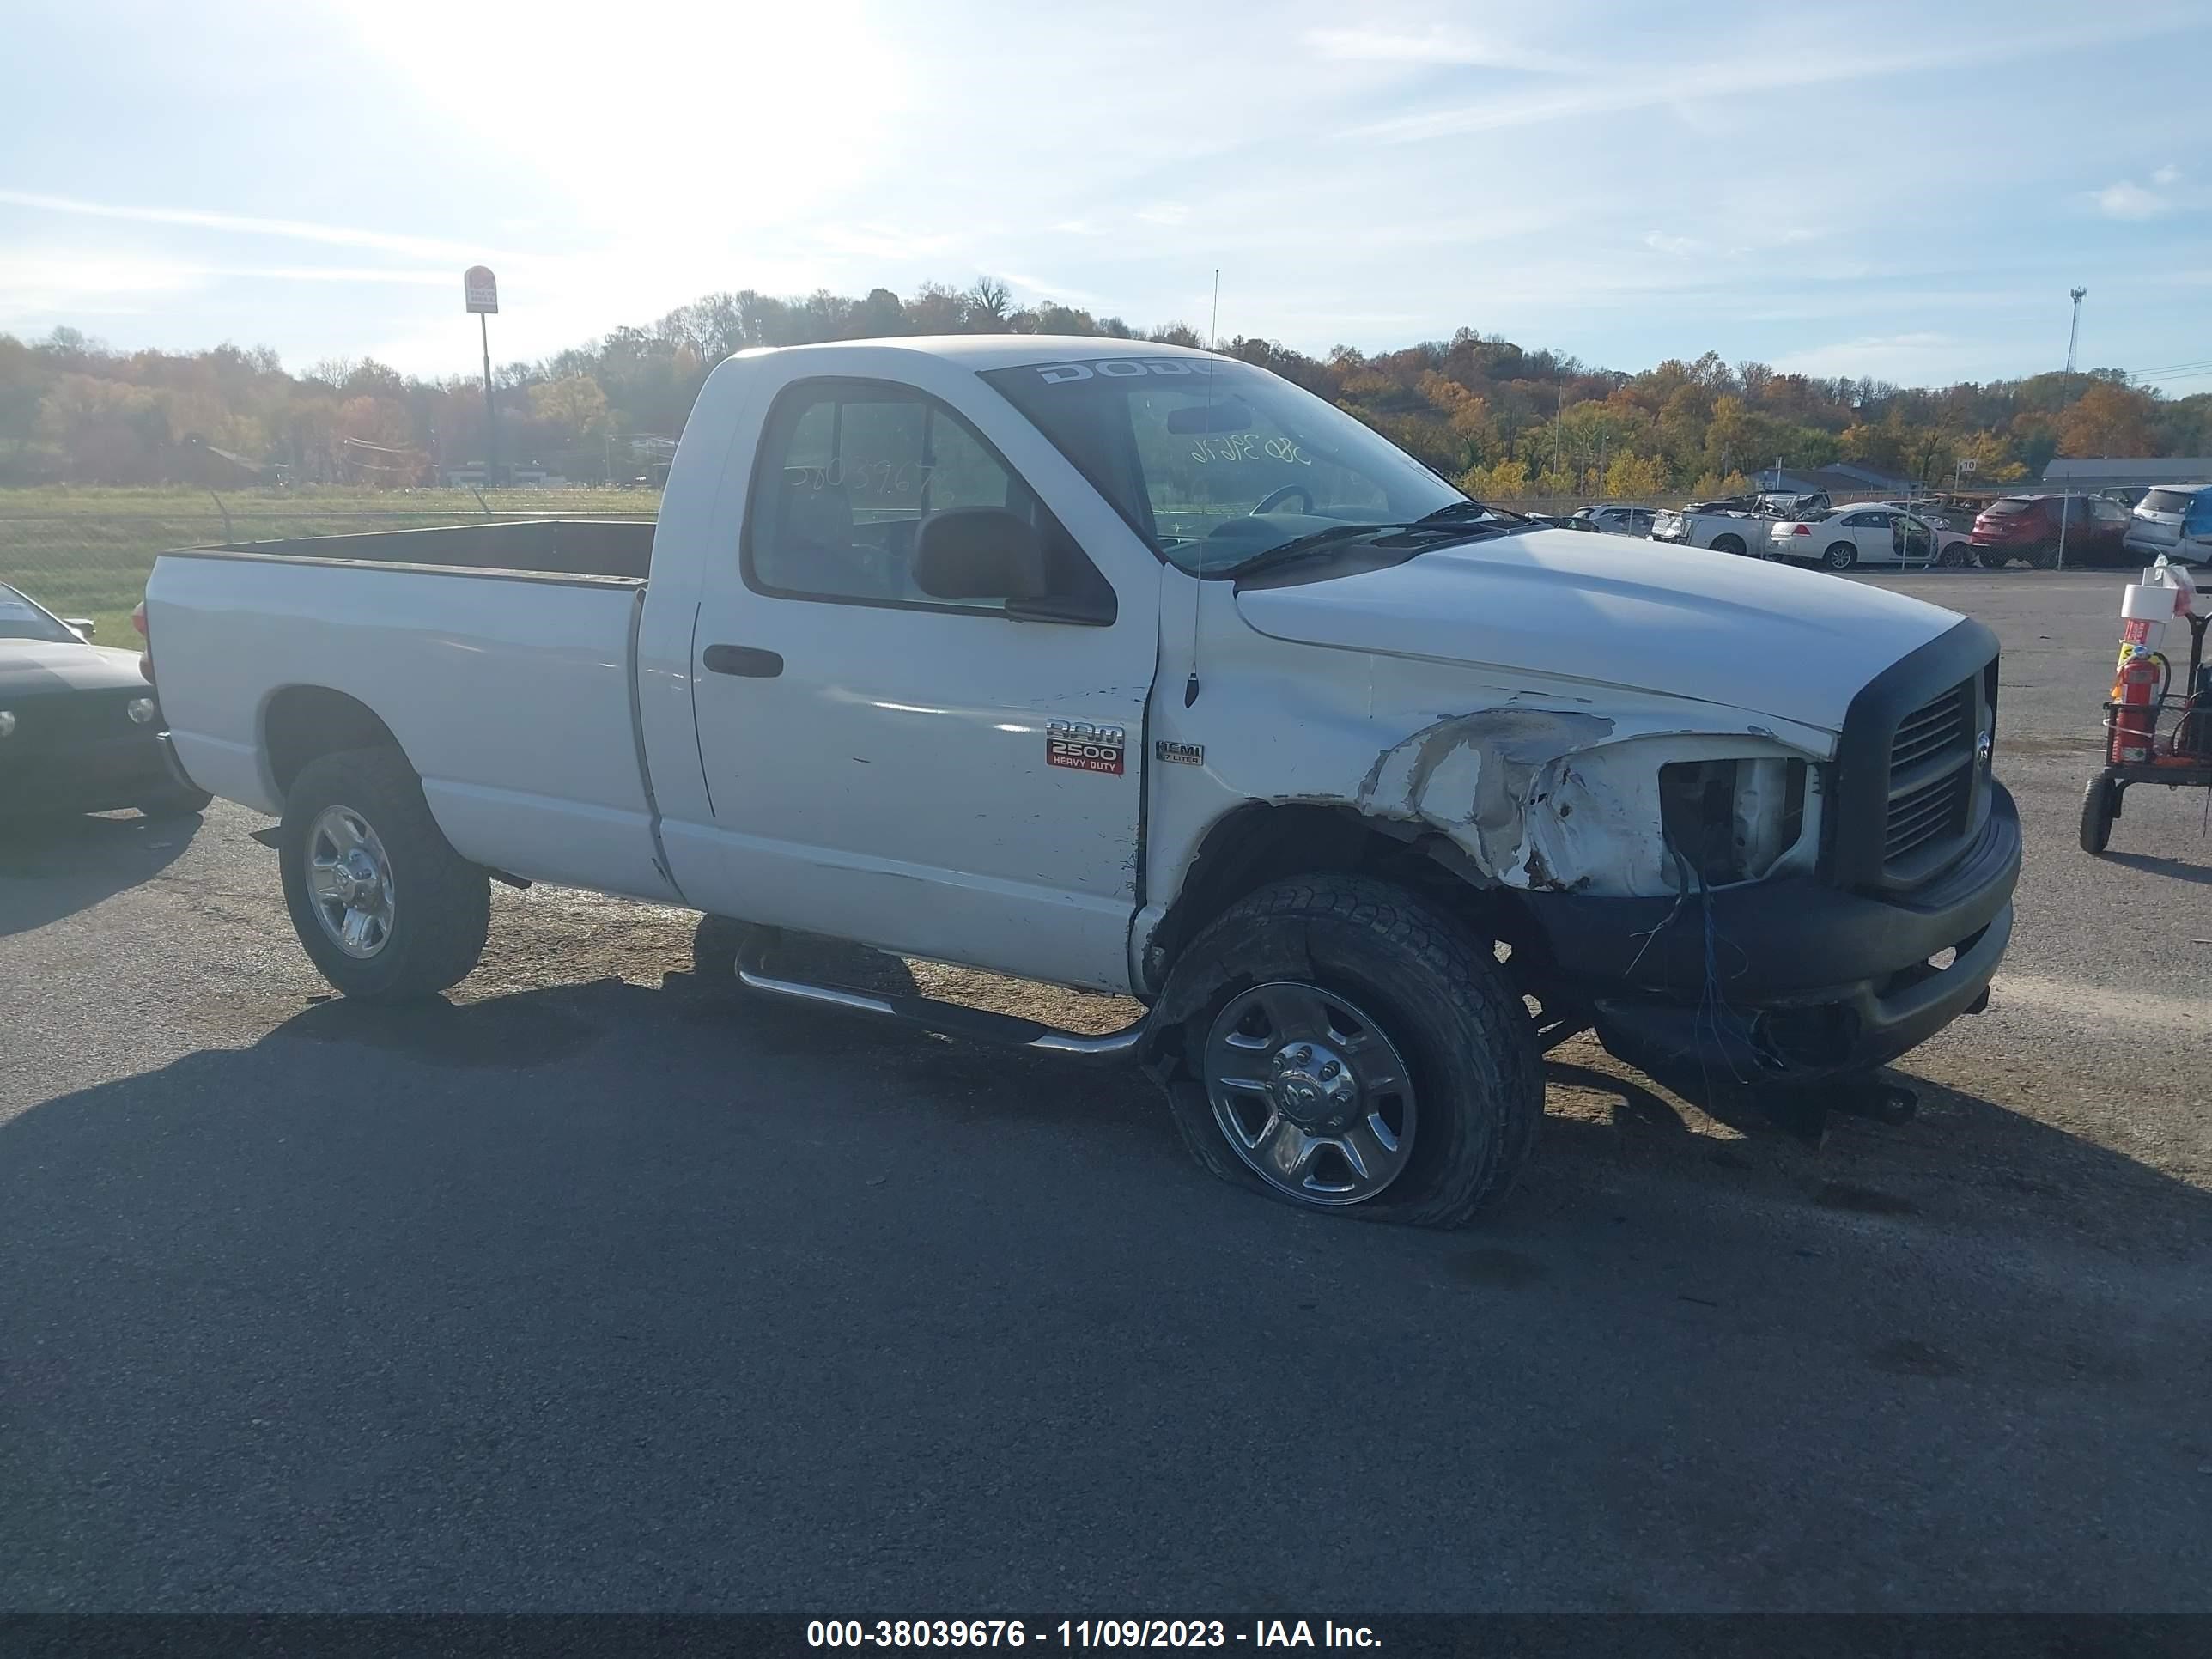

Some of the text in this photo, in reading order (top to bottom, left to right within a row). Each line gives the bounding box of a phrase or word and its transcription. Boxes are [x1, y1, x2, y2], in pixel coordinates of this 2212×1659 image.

[1045, 718, 1125, 744] RAM
[1052, 741, 1117, 761] 2500
[1054, 756, 1115, 771] HEAVY DUTY
